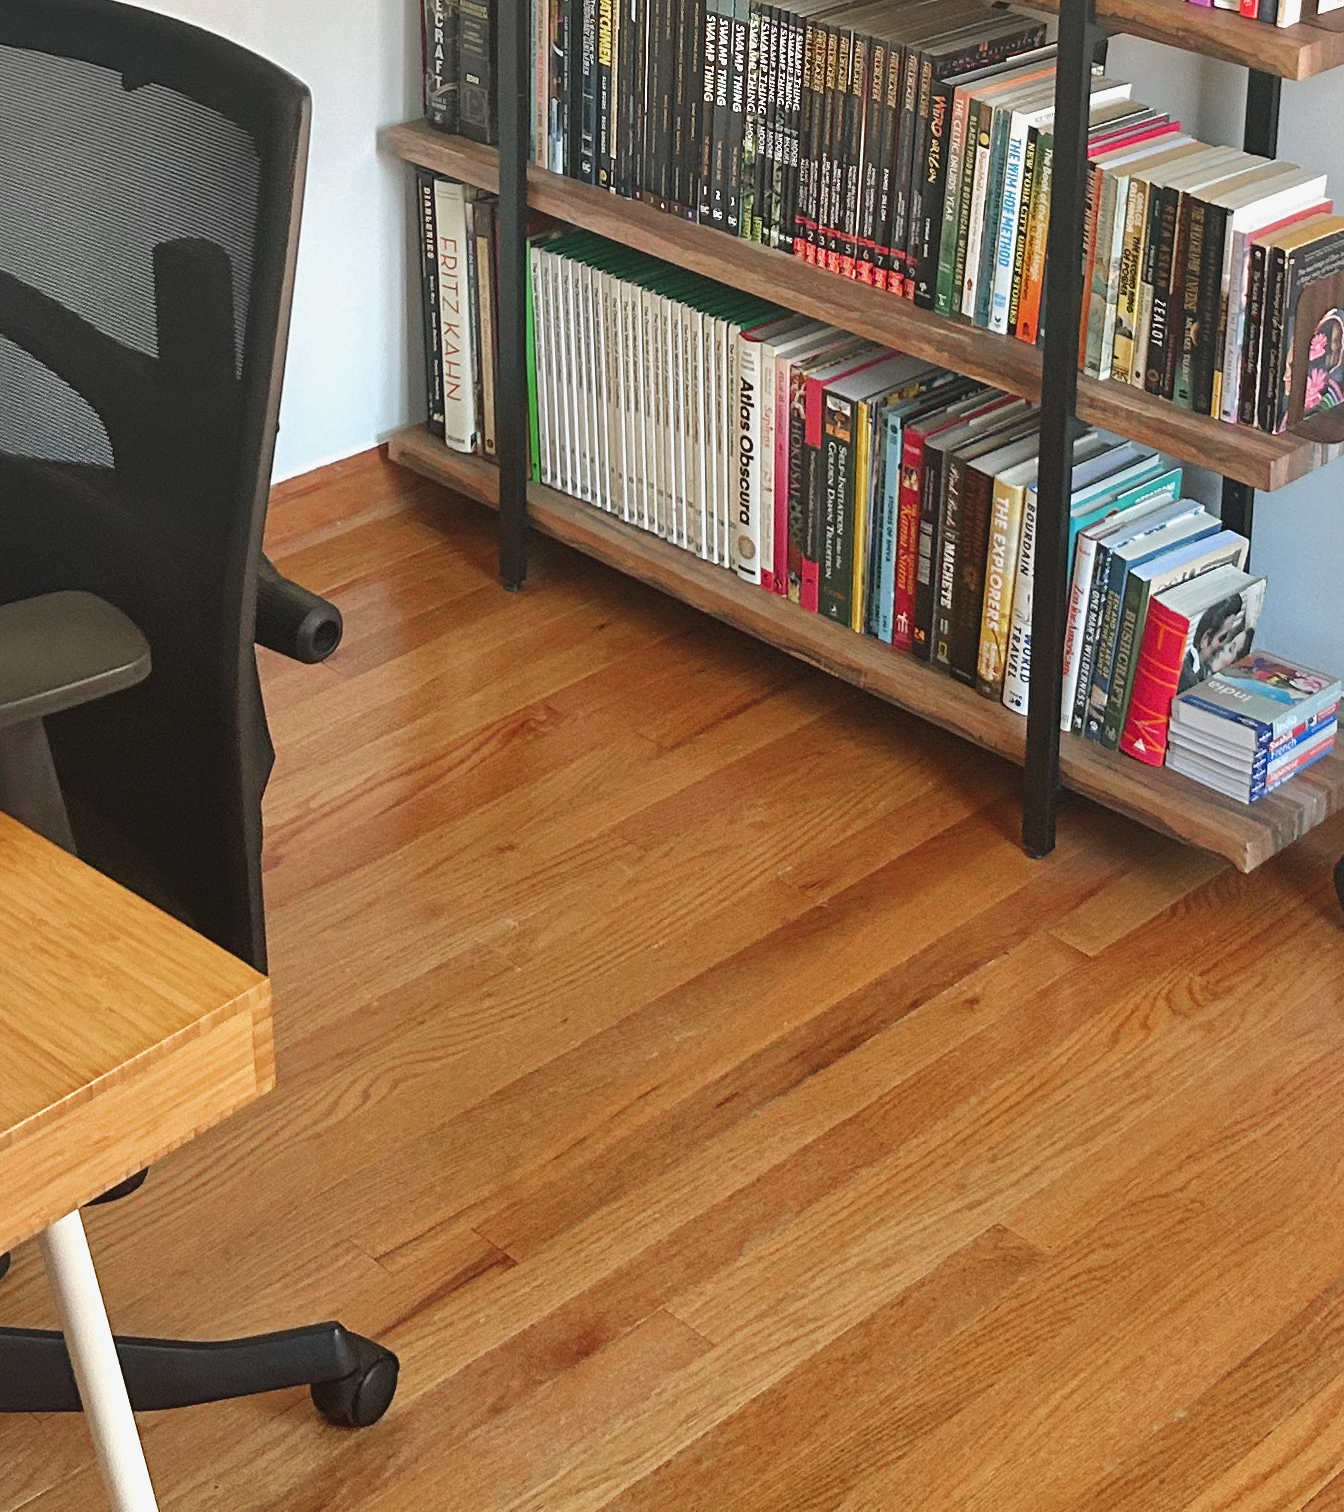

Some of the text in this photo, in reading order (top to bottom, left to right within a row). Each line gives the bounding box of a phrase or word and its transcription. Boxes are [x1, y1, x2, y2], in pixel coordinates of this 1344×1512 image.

[704, 14, 716, 102] SWAMP THING
[717, 18, 728, 107] SWAMP THING
[951, 120, 961, 152] CELTIC
[954, 99, 962, 117] THE
[424, 187, 434, 259] DIABLERIES
[945, 196, 954, 222] YEAR
[998, 138, 1021, 268] THE WIM HOF METHOD
[1009, 142, 1035, 325] NEW YORK CITY GHOST STORIES
[440, 236, 461, 401] FRITZ KAHN
[1151, 298, 1166, 347] ZEALOT
[739, 376, 754, 526] Atlas Obscura
[763, 404, 772, 448] Sapiens
[791, 419, 801, 497] HOKUSAI
[825, 441, 836, 580] GOLDEN DAWN TRADITION
[1021, 502, 1035, 576] BOURDAIN
[940, 541, 955, 609] MACHETE
[986, 496, 1009, 631] THE EXPLORERS
[1008, 626, 1022, 679] TRAVEL
[1110, 609, 1135, 708] BUSHCRAFT
[1208, 681, 1252, 703] India
[1270, 738, 1297, 760] French
